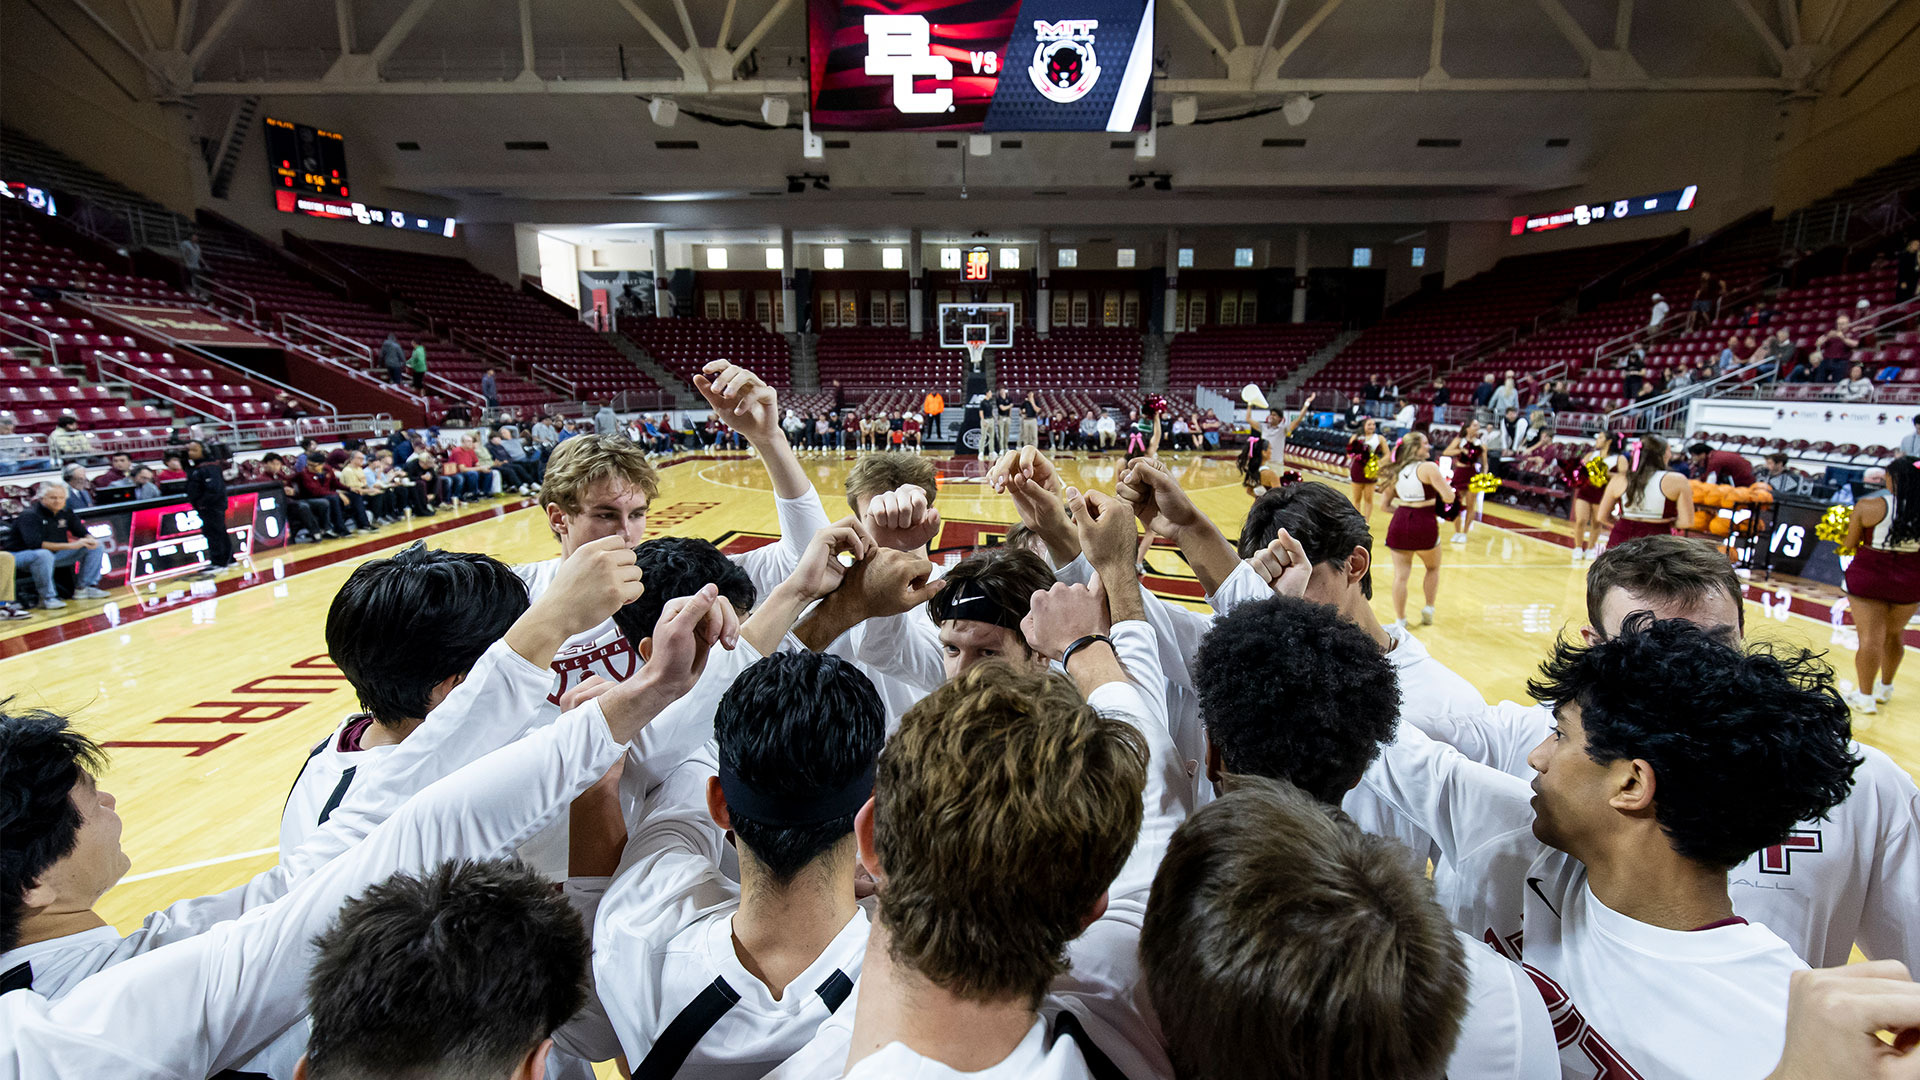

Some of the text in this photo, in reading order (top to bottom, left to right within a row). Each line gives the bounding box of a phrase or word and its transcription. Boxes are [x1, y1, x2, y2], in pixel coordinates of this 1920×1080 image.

[1034, 19, 1098, 36] MIT
[864, 14, 953, 113] BC
[970, 51, 997, 74] VS
[966, 262, 987, 279] 30
